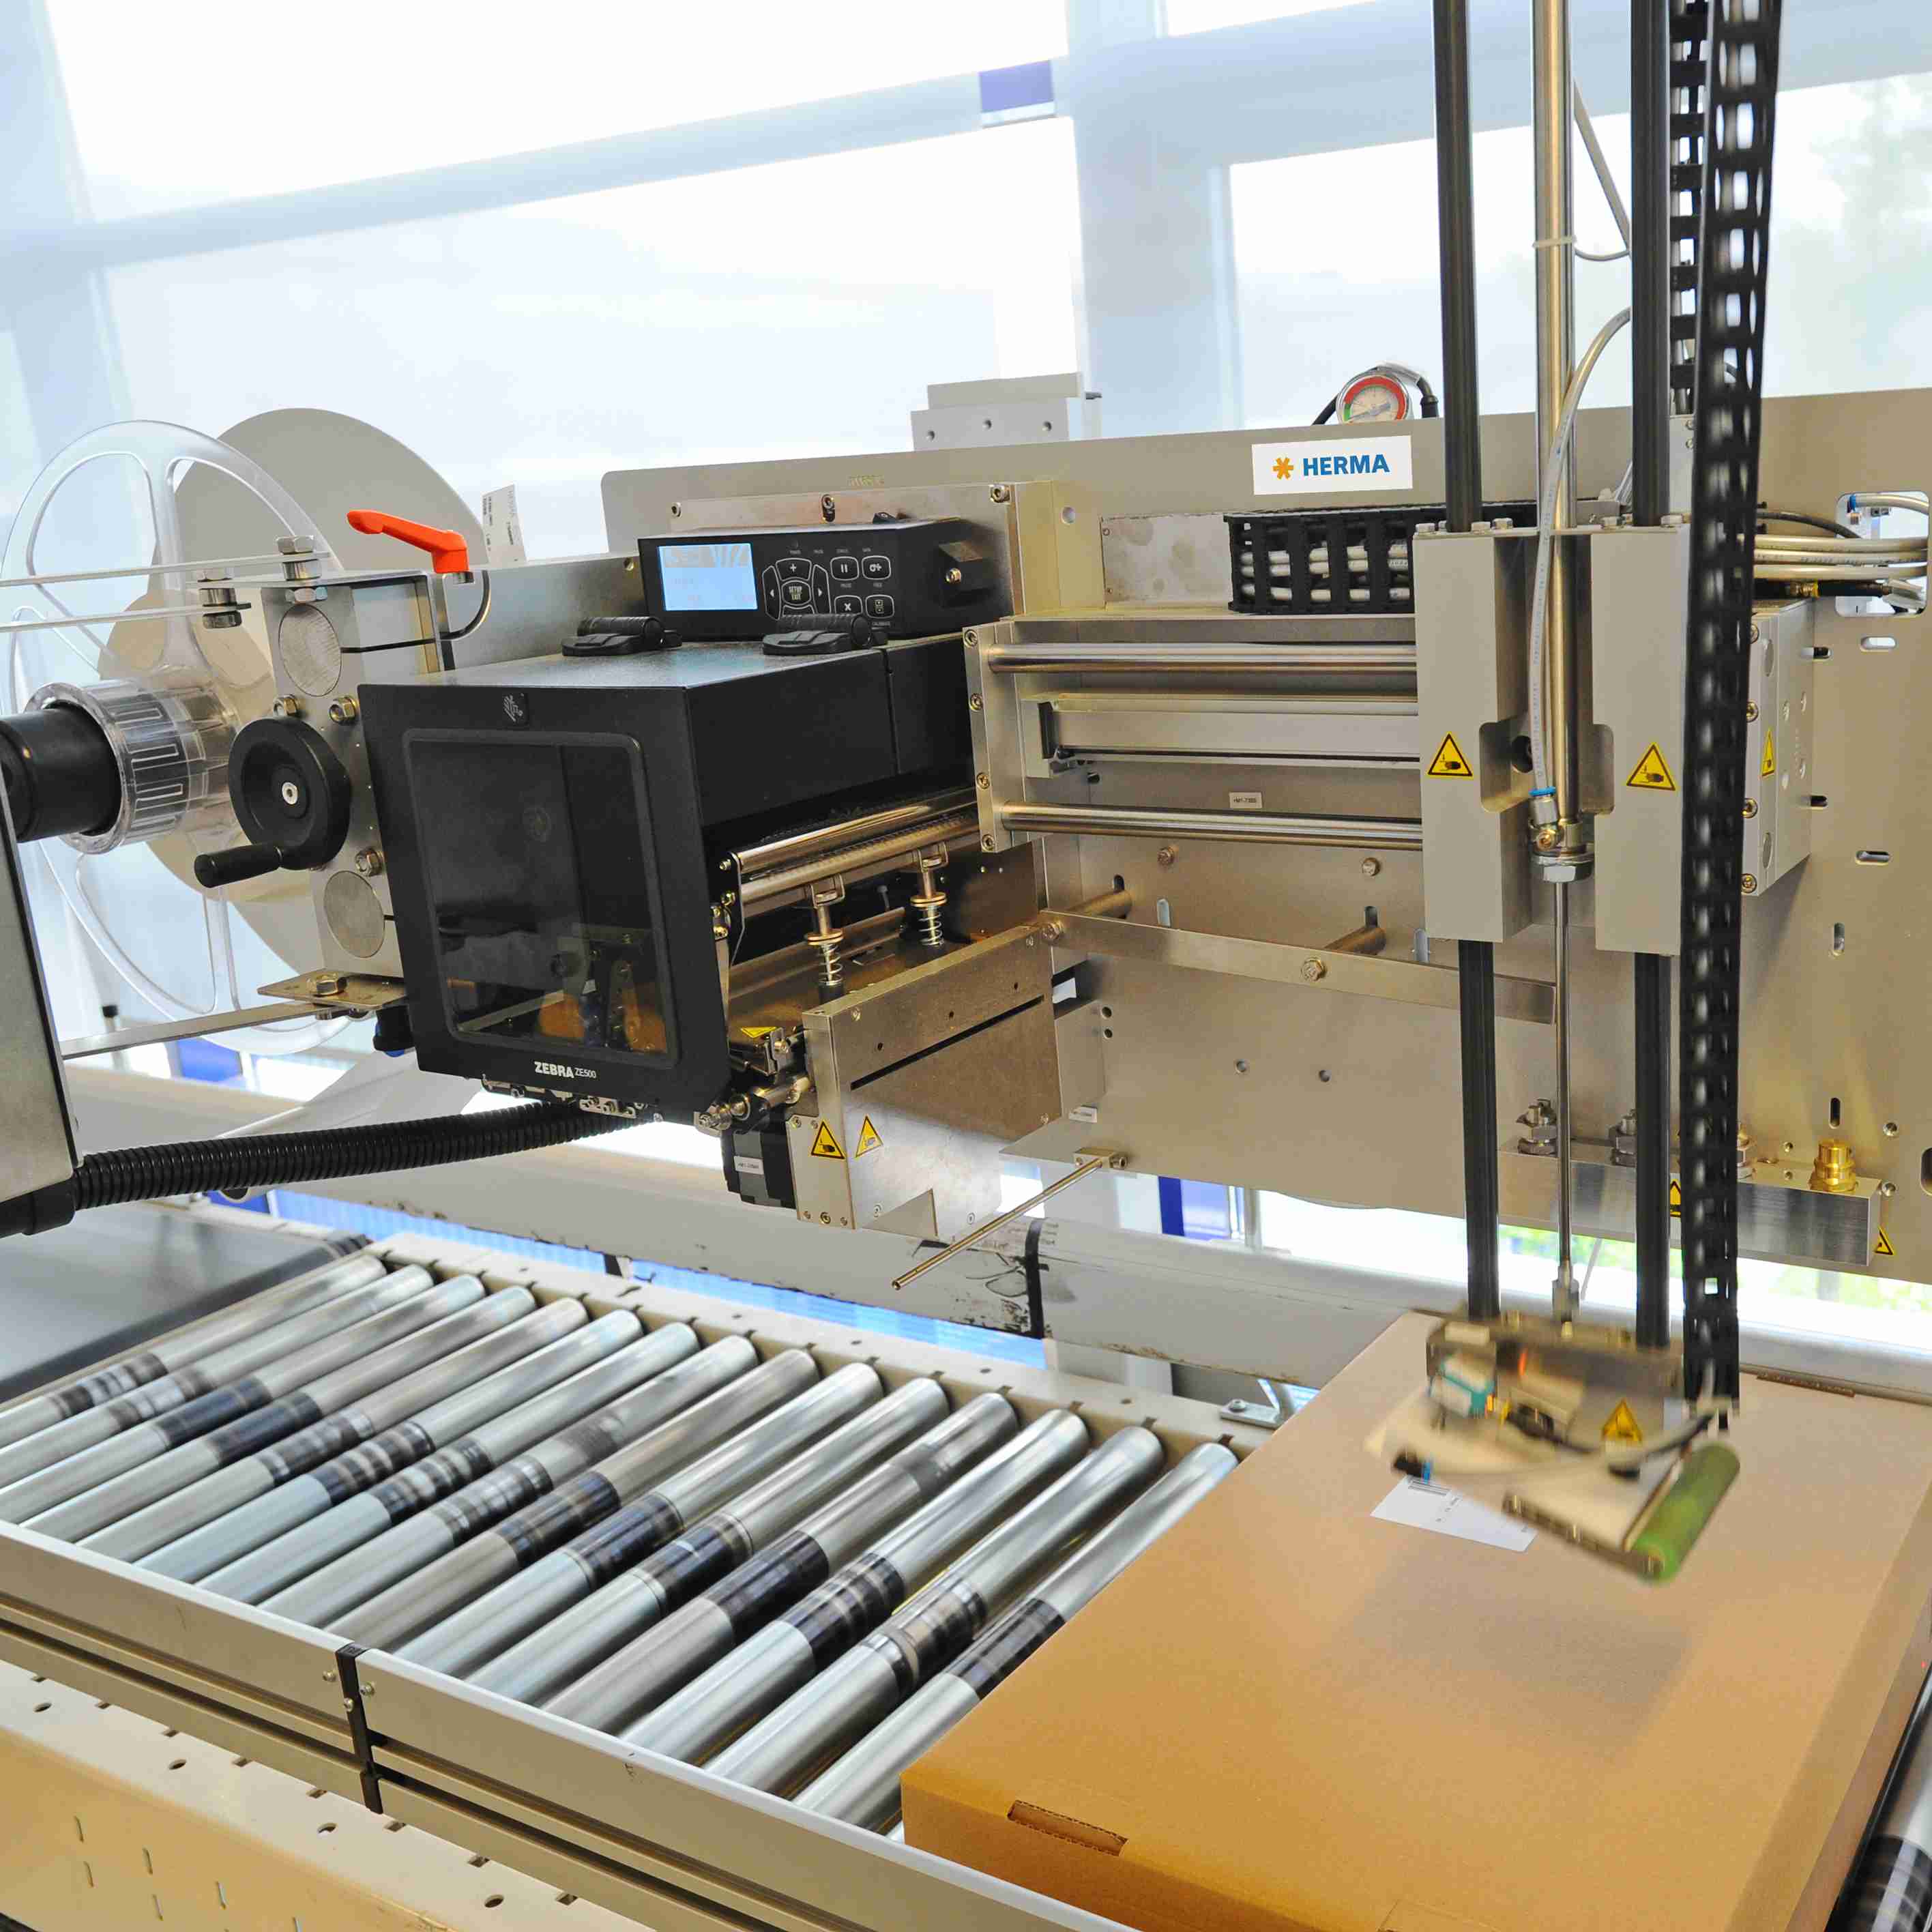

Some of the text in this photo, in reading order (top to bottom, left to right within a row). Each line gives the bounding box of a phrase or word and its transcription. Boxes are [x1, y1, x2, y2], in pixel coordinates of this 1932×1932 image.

[1302, 454, 1390, 476] HERMA
[534, 1061, 597, 1079] ZEBRA ZE500
